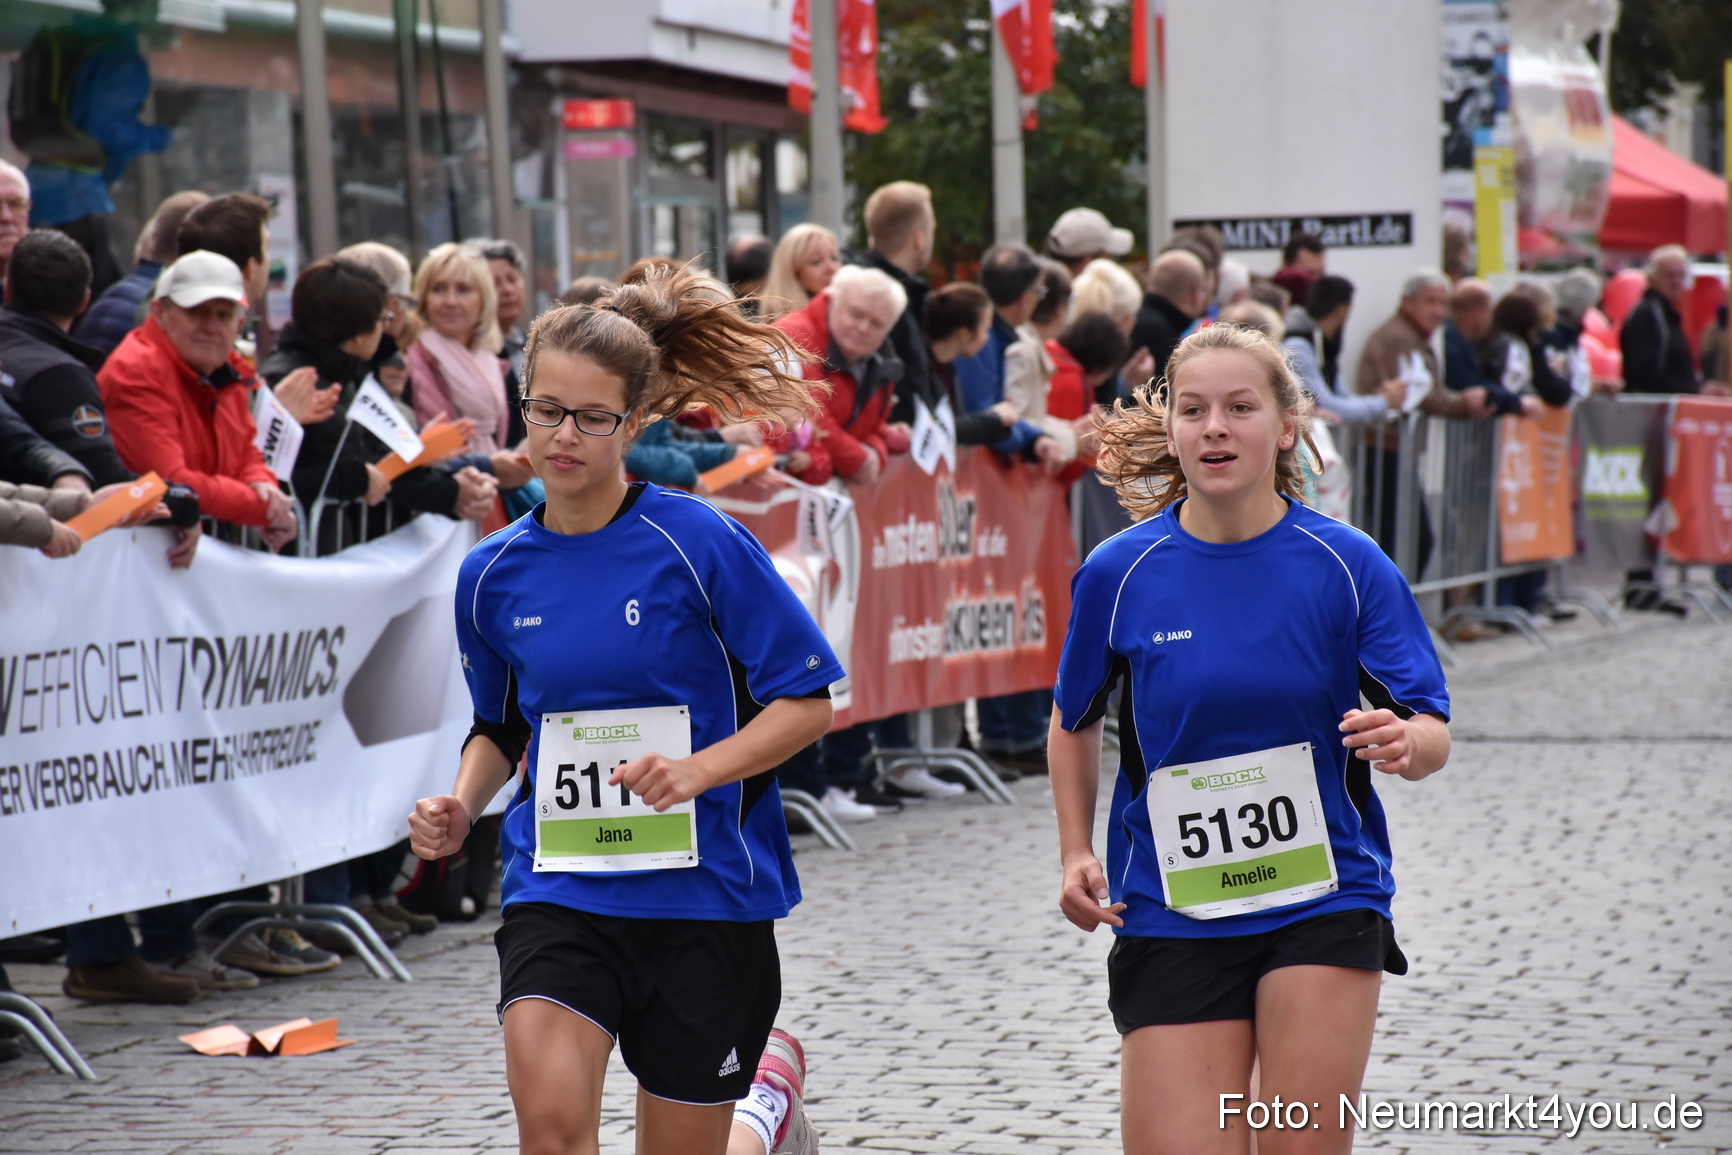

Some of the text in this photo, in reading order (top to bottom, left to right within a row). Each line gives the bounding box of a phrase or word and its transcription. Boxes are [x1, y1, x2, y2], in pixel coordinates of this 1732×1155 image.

[522, 616, 542, 627] JAKO
[625, 598, 641, 627] 6
[1166, 629, 1193, 642] JAKO
[585, 724, 640, 740] BOCK
[25, 743, 172, 811] VERBRAUCH.
[555, 760, 632, 810] 511
[1207, 766, 1267, 788] BOCK
[542, 804, 549, 815] S
[595, 826, 633, 844] Jana
[1178, 795, 1299, 859] 5130
[1167, 856, 1175, 867] S
[1221, 865, 1278, 889] Amelie
[718, 1063, 740, 1077] adidas
